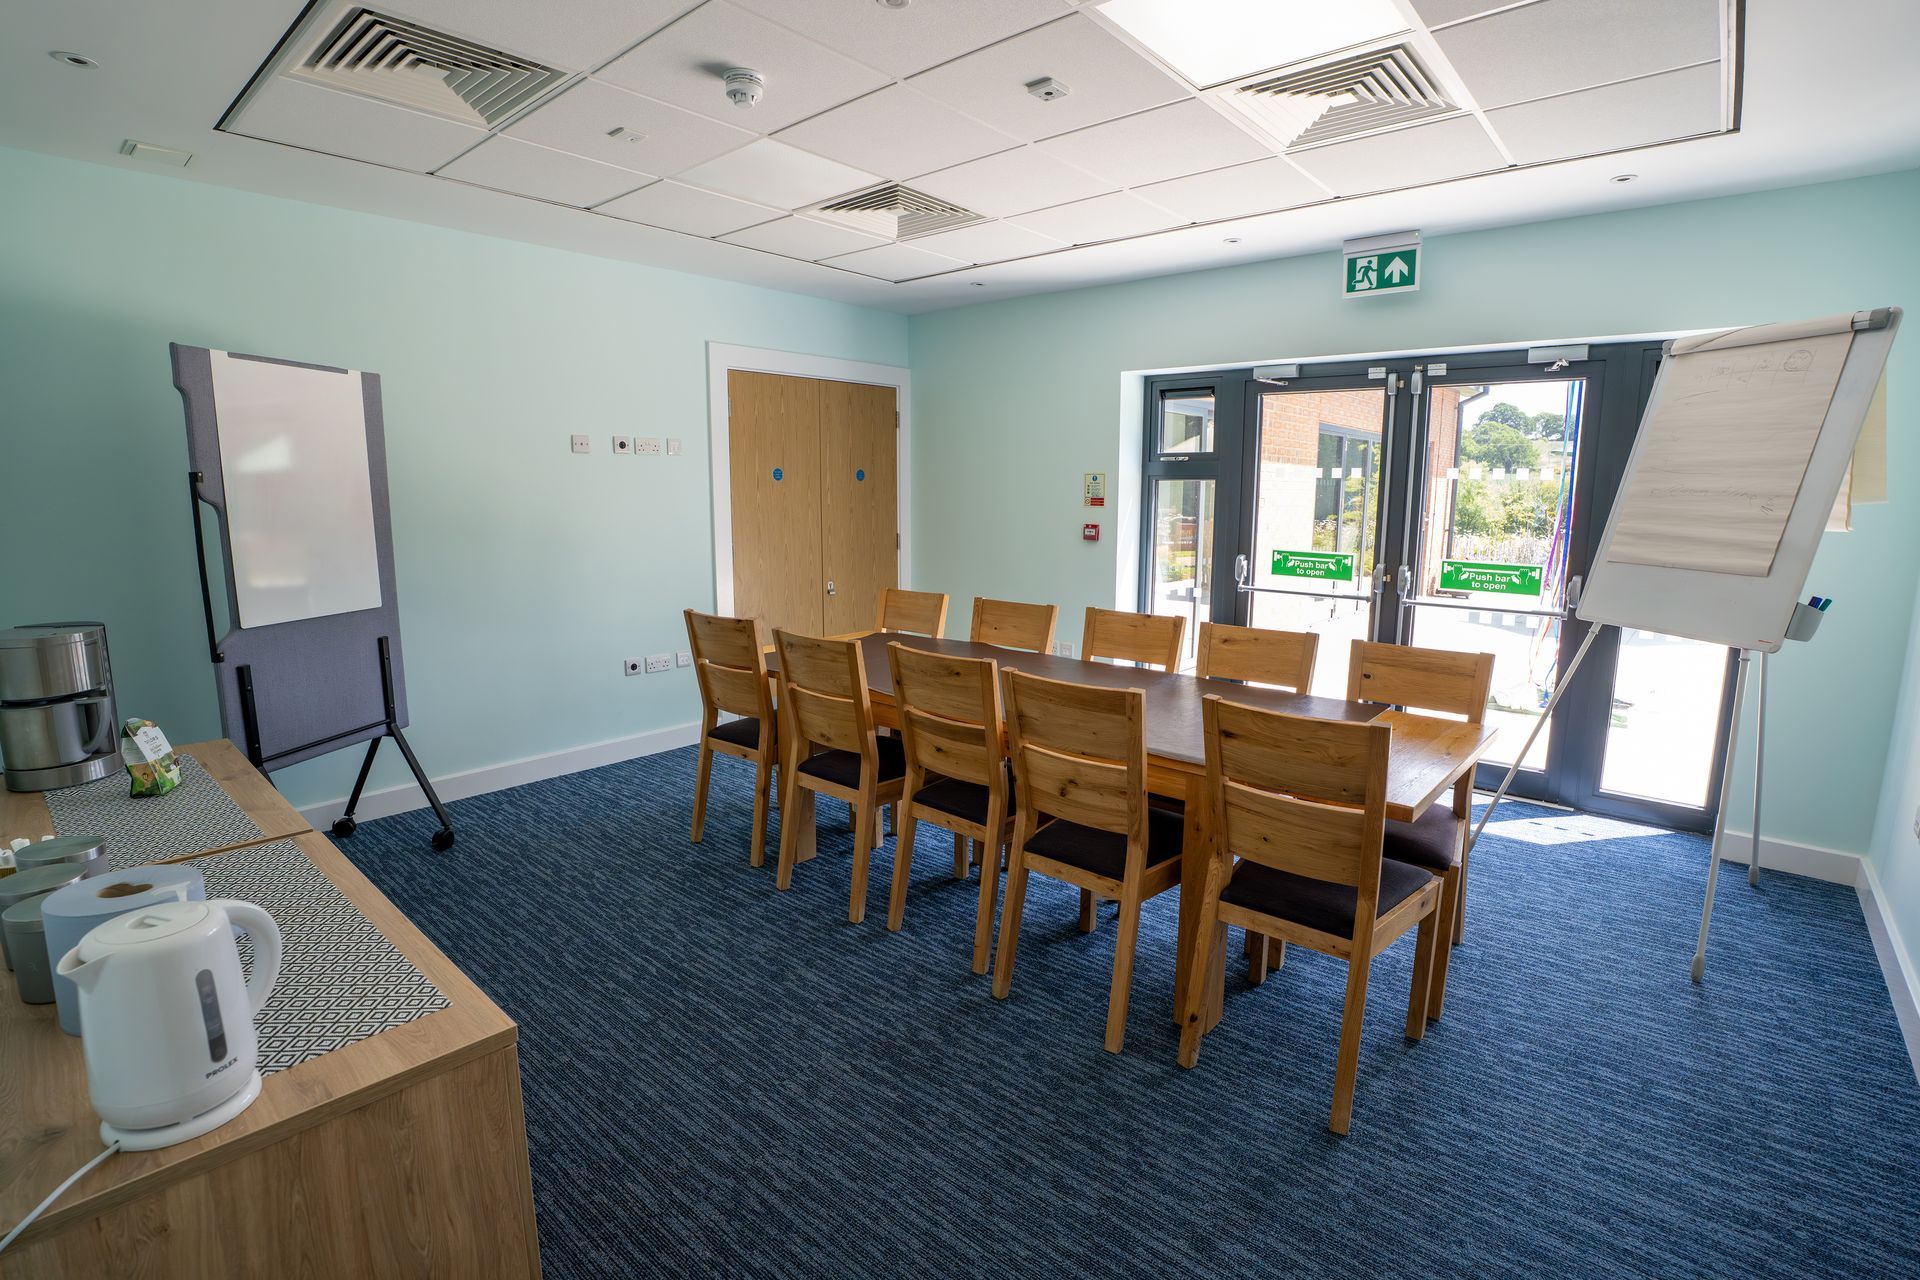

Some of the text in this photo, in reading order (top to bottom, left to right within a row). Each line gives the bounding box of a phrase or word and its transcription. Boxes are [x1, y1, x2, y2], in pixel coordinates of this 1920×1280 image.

[1294, 560, 1314, 568] Push
[1469, 572, 1511, 583] Push bar
[1483, 582, 1506, 590] open
[205, 1056, 238, 1079] PROLEX
